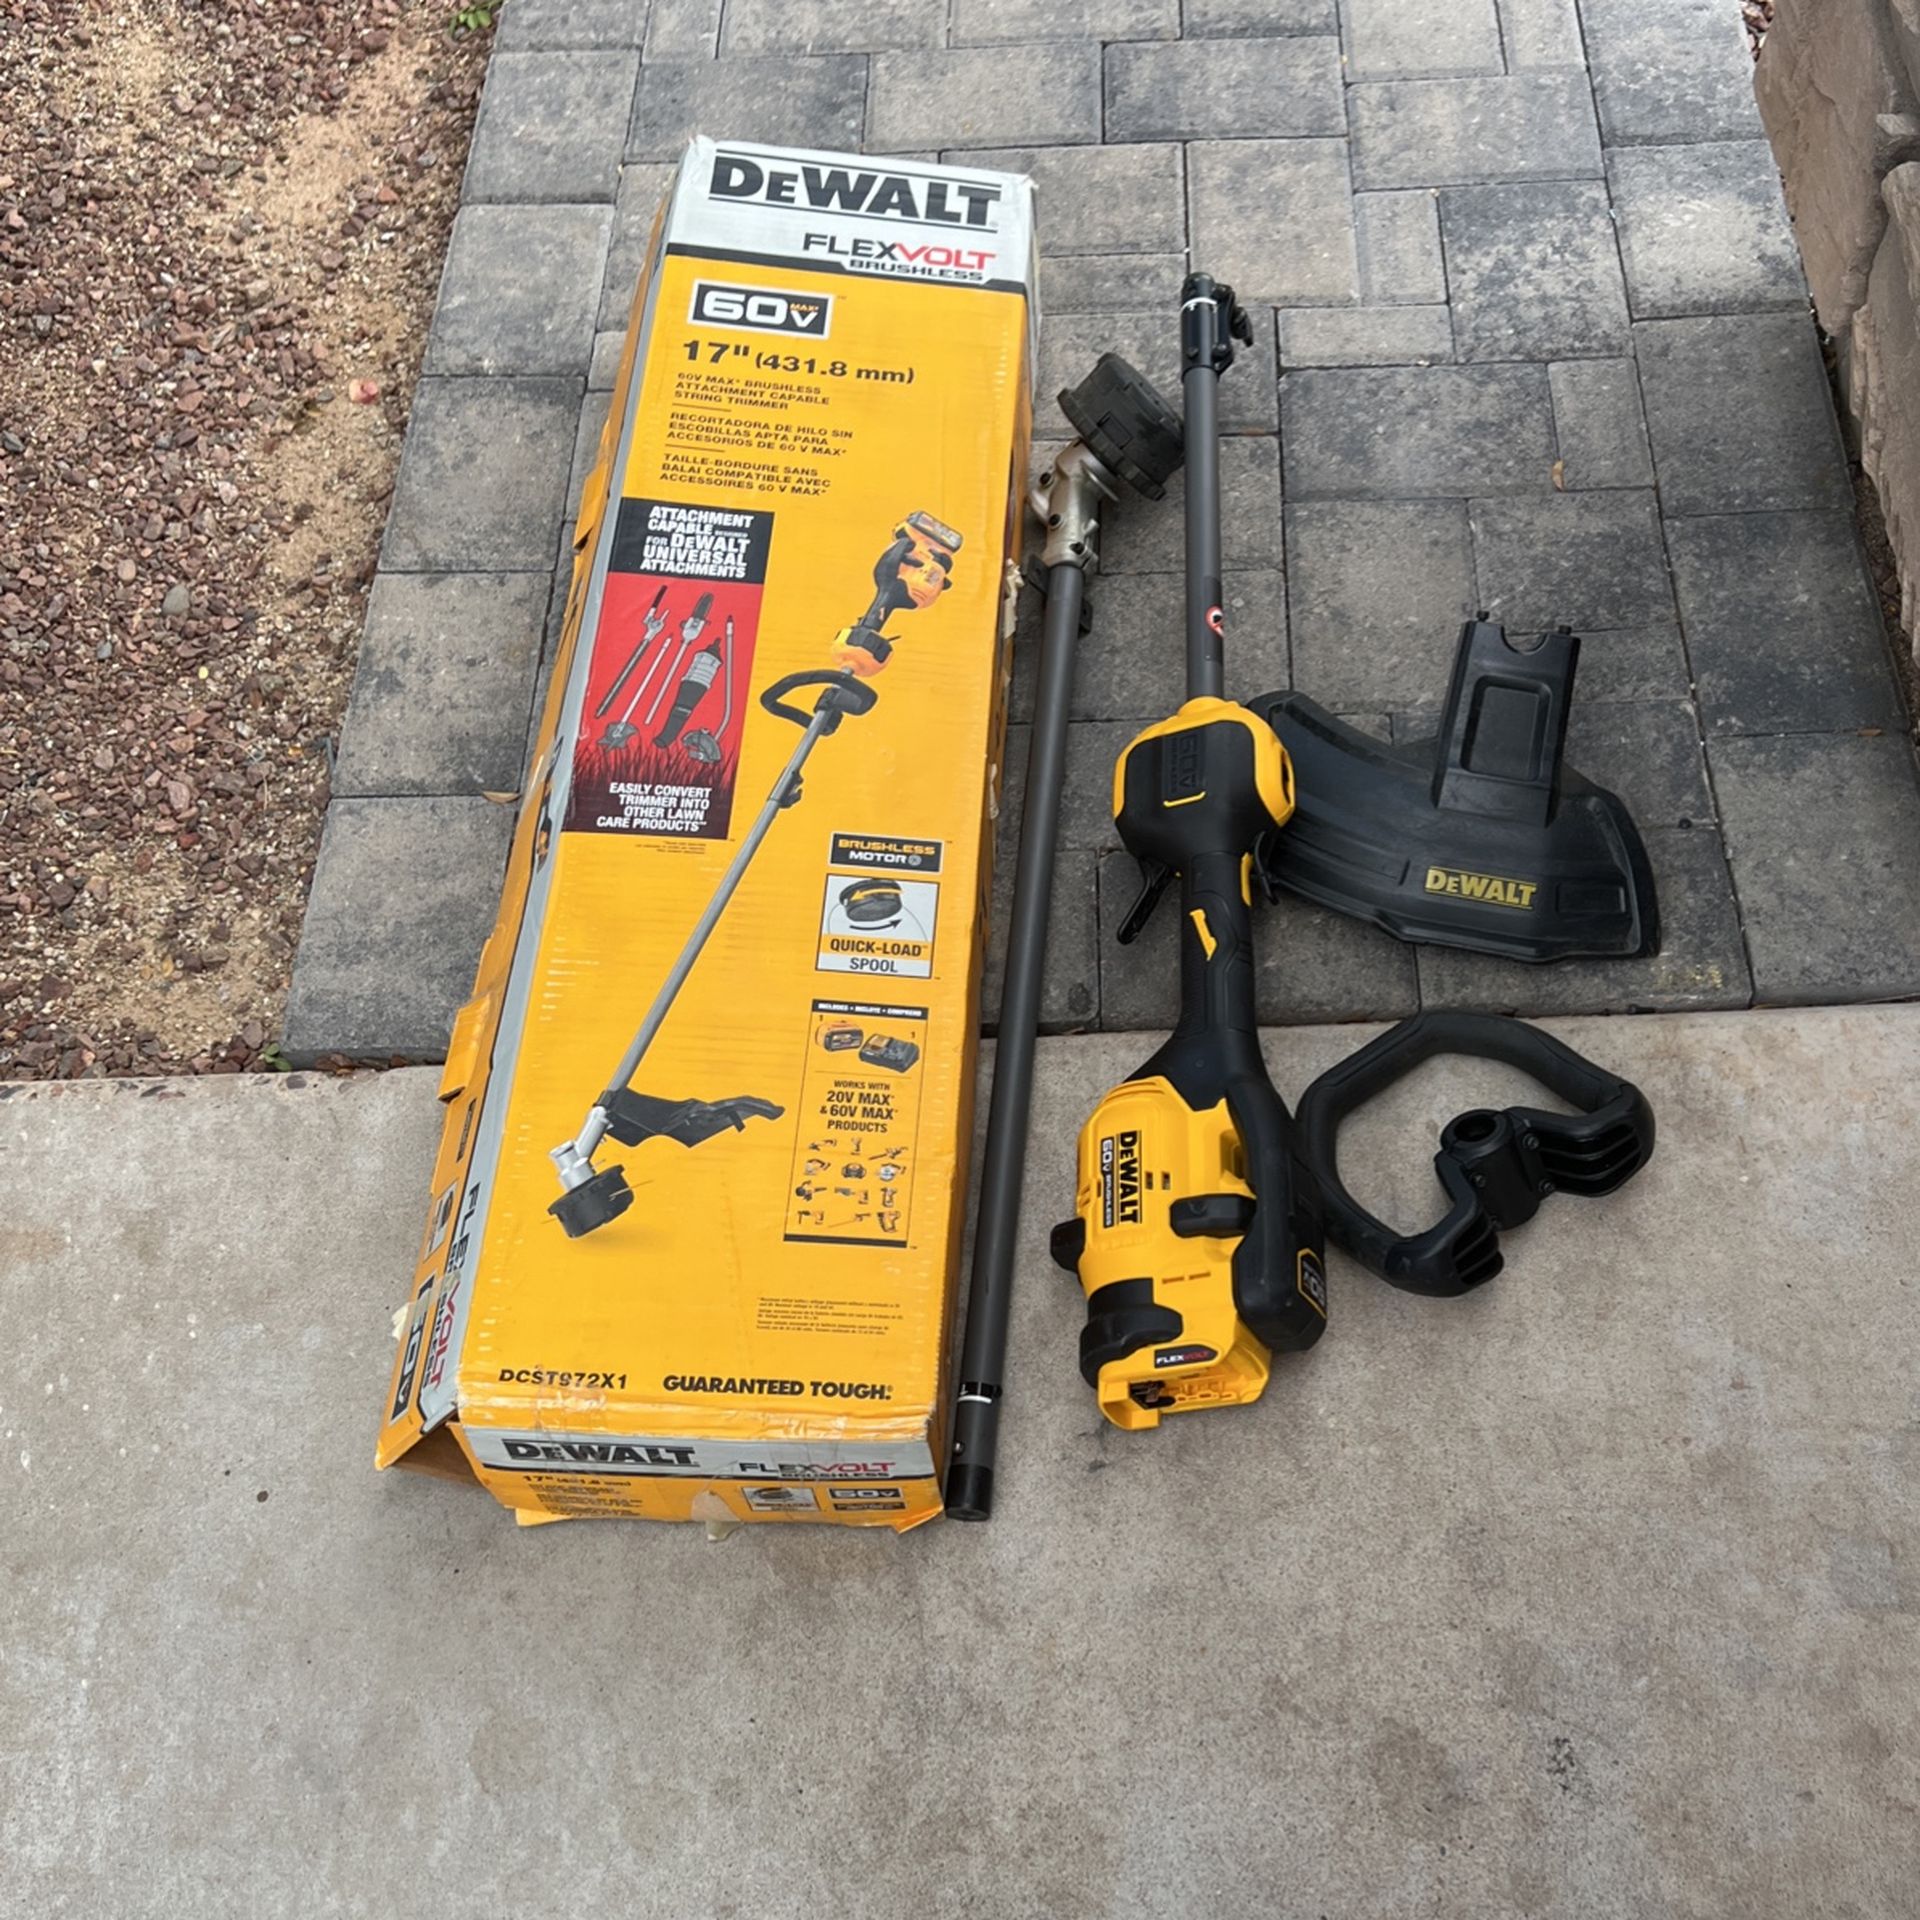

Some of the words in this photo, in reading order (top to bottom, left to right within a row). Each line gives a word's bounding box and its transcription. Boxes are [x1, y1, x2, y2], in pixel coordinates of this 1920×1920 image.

[709, 156, 1001, 226] DEWALT
[803, 233, 996, 271] FLEXVOLT
[850, 259, 983, 281] BRUSHLESS
[683, 340, 750, 364] 17"
[755, 352, 848, 378] (431.8
[856, 368, 914, 384] mm)
[675, 381, 764, 398] ATTACHMENT
[770, 391, 829, 405] CAPABLE
[678, 372, 701, 382] 60V
[744, 377, 821, 395] BRUSHLESS
[674, 390, 722, 404] STRING
[728, 396, 789, 410] TRIMMER
[669, 422, 750, 438] ESCOBILLAS
[755, 431, 788, 442] APTA
[793, 435, 828, 445] PARA
[671, 412, 770, 431] RECORTADORA
[776, 424, 793, 433] DE
[797, 425, 827, 436] HILO
[832, 429, 852, 439] SIN
[667, 431, 753, 447] ACCESORIOS
[757, 440, 775, 450] DE
[779, 442, 796, 452] 60
[800, 445, 810, 453] V
[662, 463, 701, 475] BALAI
[705, 467, 791, 484] COMPATIBLE
[796, 477, 831, 488] AVEC
[664, 453, 779, 473] TAILLE-BORDURE
[783, 466, 818, 477] SANS
[660, 473, 754, 490] ACCESSOIRES
[758, 482, 774, 492] 60
[779, 484, 788, 493] V
[648, 518, 713, 535] CAPABLE
[649, 505, 754, 528] ATTACHMENT
[646, 535, 668, 546] FOR
[670, 533, 751, 554] DEWALT
[643, 544, 747, 567] UNIVERSAL
[640, 558, 746, 579] ATTACHMENTS
[609, 782, 652, 795] EASILY
[654, 785, 712, 798] CONVERT
[619, 794, 677, 808] TRIMMER
[680, 798, 710, 810] INTO
[596, 816, 630, 828] CARE
[624, 806, 664, 818] OTHER
[667, 809, 704, 821] LAWN
[838, 839, 936, 856] BRUSHLESS
[849, 851, 906, 864] MOTOR
[1425, 868, 1537, 906] DEWALT
[830, 938, 921, 957] QUICK-LOAD
[849, 957, 898, 973] SPOOL
[834, 1080, 866, 1089] WORKS
[868, 1082, 890, 1090] WITH
[827, 1090, 854, 1103] 20V
[820, 1105, 827, 1114] &
[830, 1104, 857, 1117] 60V
[827, 1120, 888, 1133] PRODUCTS
[1120, 1130, 1138, 1224] DEWALT
[499, 1368, 627, 1390] DCST972X1
[662, 1374, 804, 1396] GUARANTEED
[503, 1442, 696, 1465] DEWALT
[739, 1462, 896, 1473] FLEXVOLT
